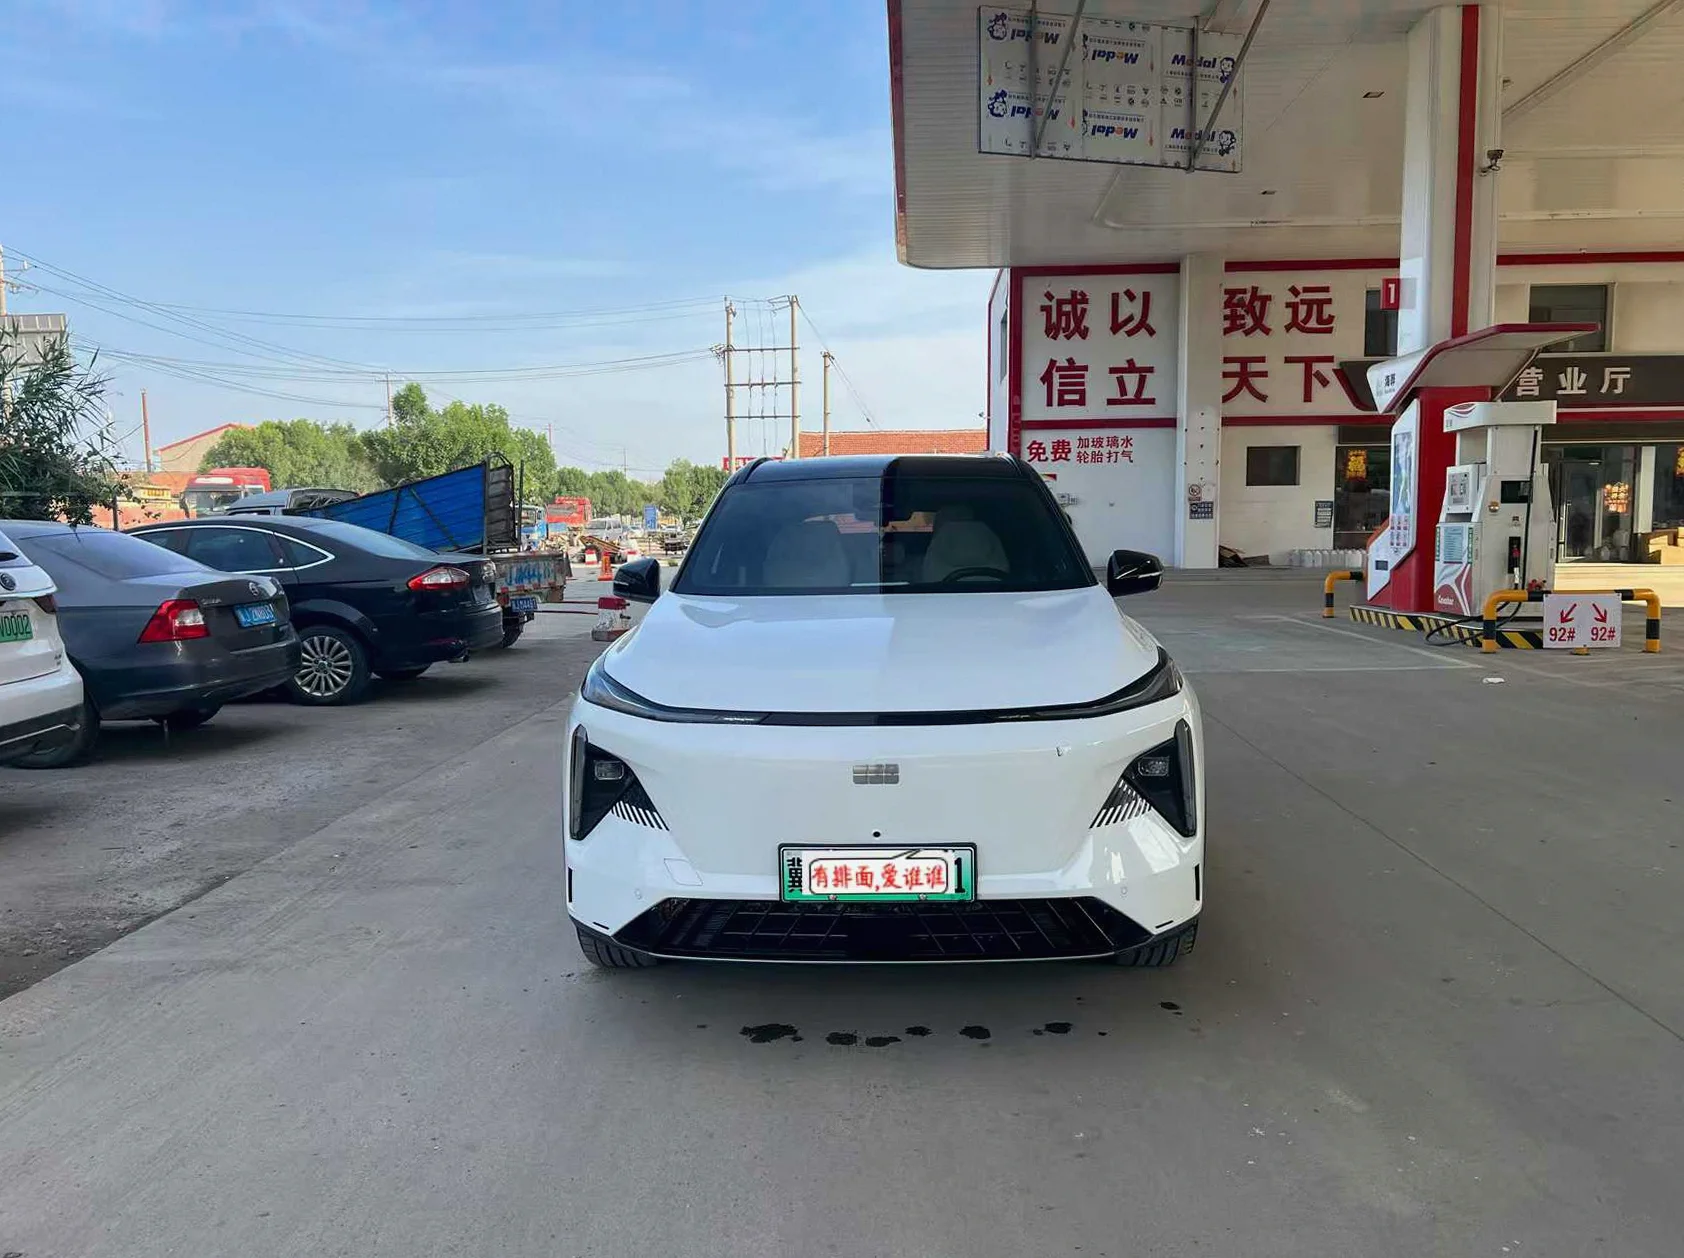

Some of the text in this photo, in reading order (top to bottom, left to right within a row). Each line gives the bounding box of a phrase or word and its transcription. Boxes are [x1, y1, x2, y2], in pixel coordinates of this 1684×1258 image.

[1091, 48, 1140, 65] Medal
[1091, 124, 1139, 140] Medal
[1386, 282, 1396, 303] 1
[1516, 367, 1631, 396] 营业厅
[1026, 439, 1072, 463] 免费
[1076, 435, 1134, 449] 加玻璃水
[1076, 450, 1134, 465] 轮胎打气
[1549, 626, 1616, 642] 92# 92#
[812, 863, 945, 891] 有排面,爱谁谁
[954, 857, 966, 893] 1
